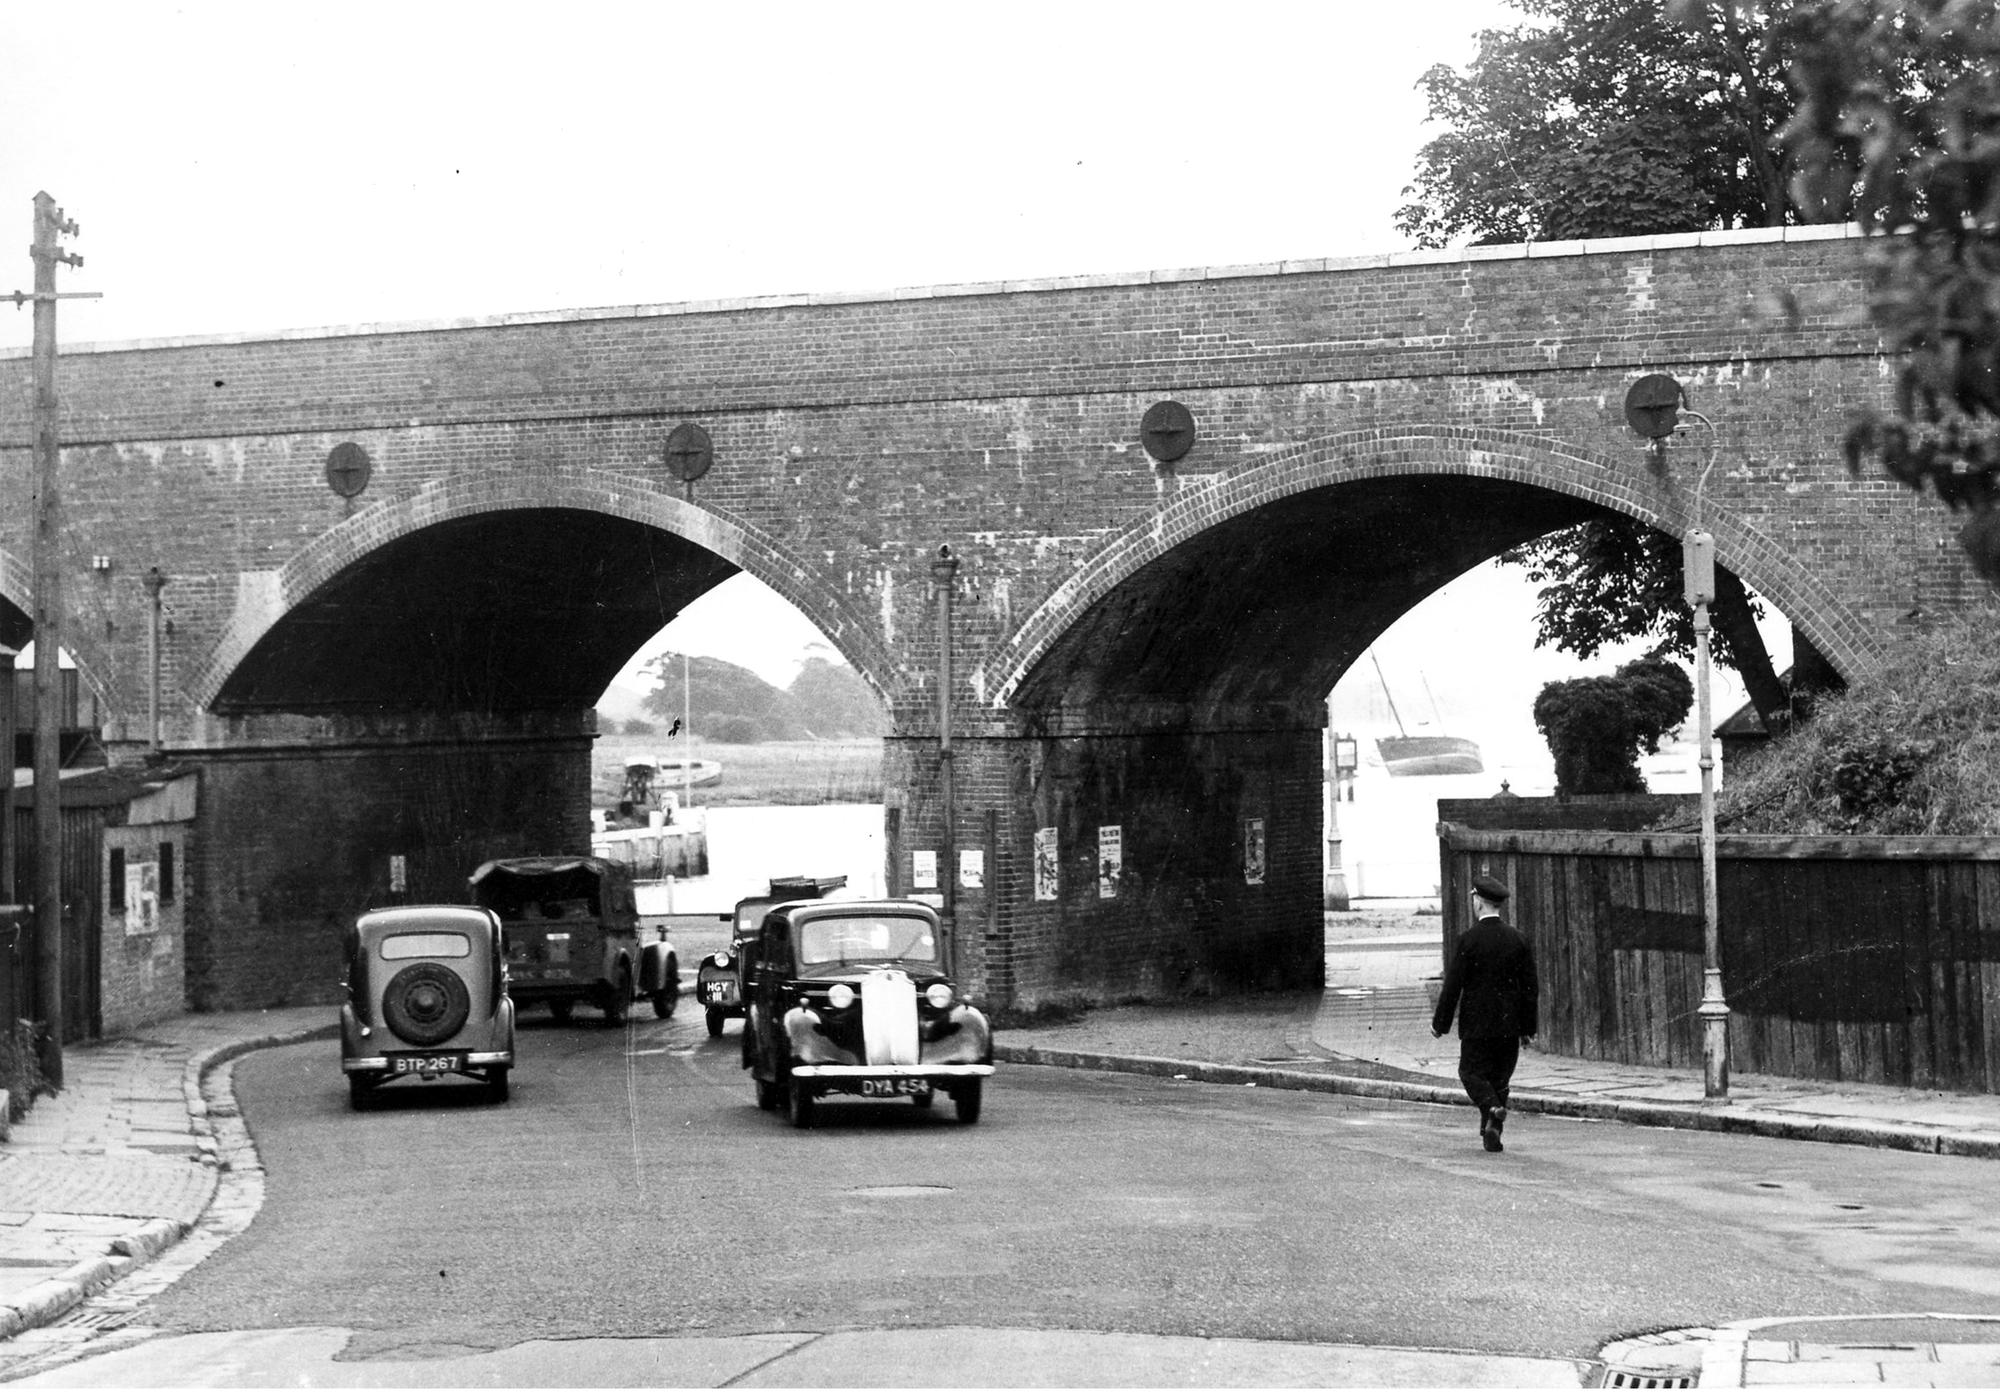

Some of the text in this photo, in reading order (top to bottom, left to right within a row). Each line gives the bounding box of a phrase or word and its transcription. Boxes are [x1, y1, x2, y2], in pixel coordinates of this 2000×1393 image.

[707, 982, 728, 992] HGY
[396, 1057, 458, 1071] BTP 267
[862, 1078, 929, 1094] DYA 454
